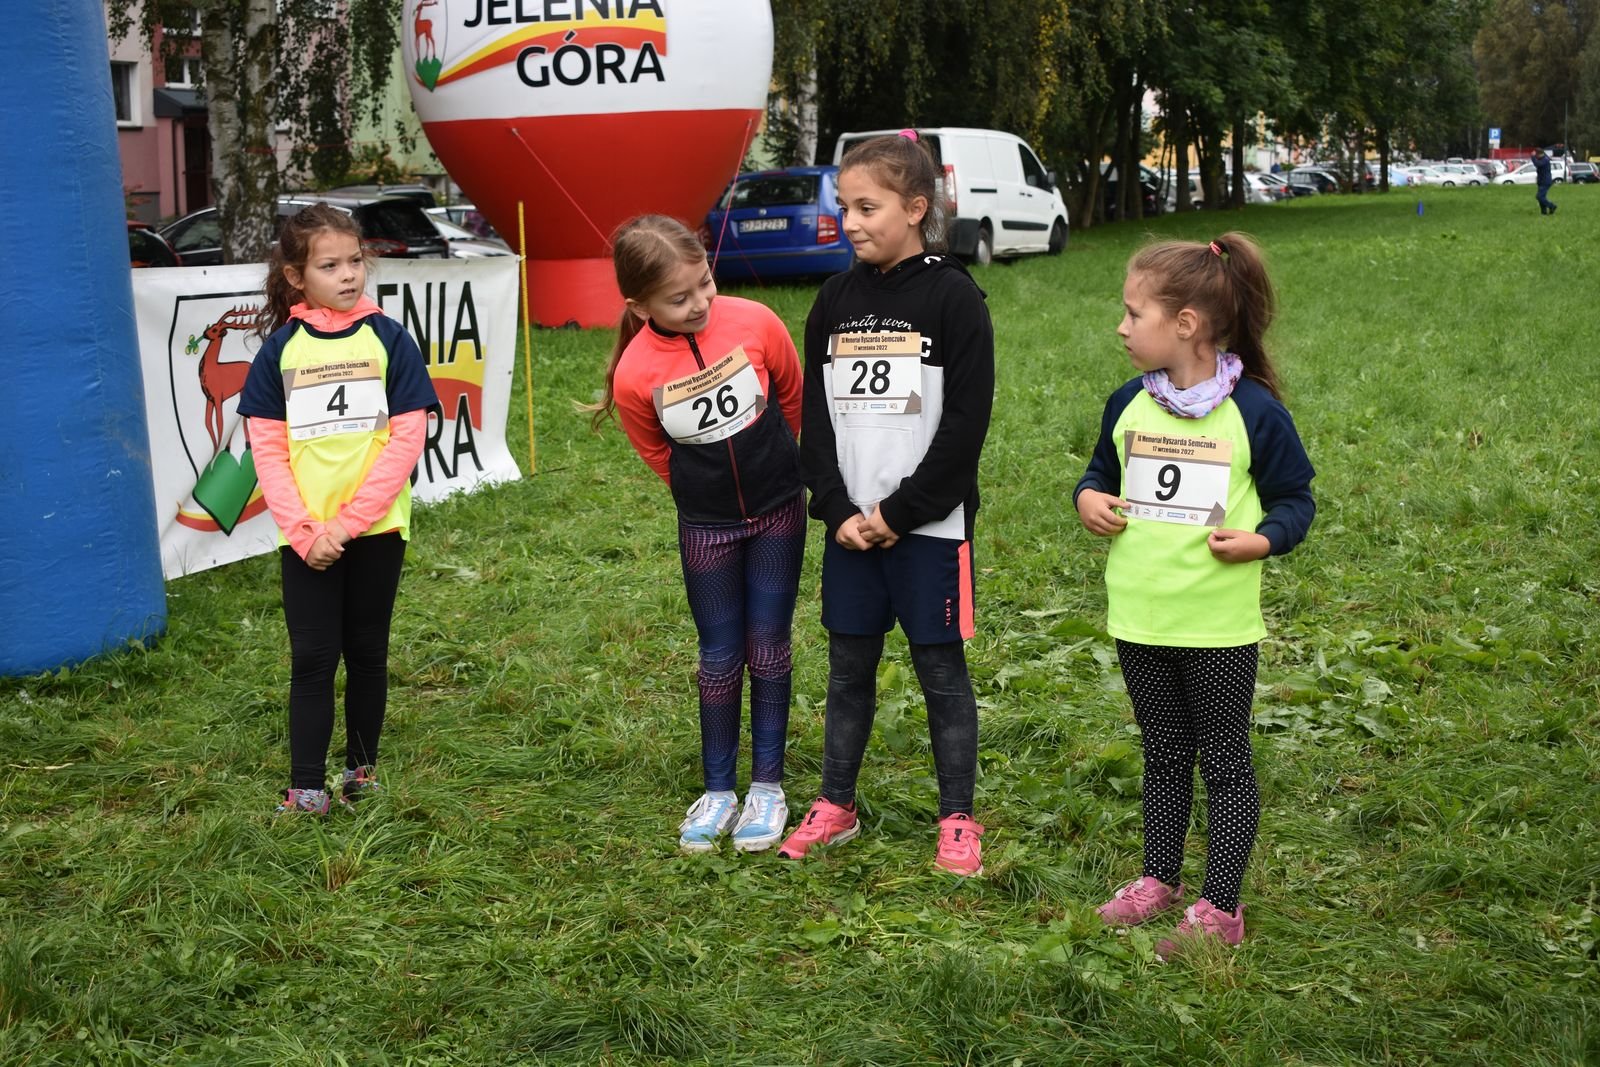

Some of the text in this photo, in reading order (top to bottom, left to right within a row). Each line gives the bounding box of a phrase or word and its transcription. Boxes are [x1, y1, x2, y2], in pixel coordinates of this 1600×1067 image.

[464, 0, 663, 27] JELENIA
[517, 29, 665, 88] GÓRA
[1491, 128, 1499, 138] P
[838, 314, 913, 333] ninety seven
[881, 335, 906, 343] Semczuka
[712, 355, 734, 373] Semczuka
[712, 372, 723, 382] 2022
[850, 359, 891, 395] 28
[326, 384, 349, 417] 4
[692, 384, 739, 431] 26
[411, 395, 484, 488] RA
[1162, 436, 1188, 447] Ryszarda
[1188, 438, 1217, 449] Semczuka
[1155, 463, 1182, 502] 9
